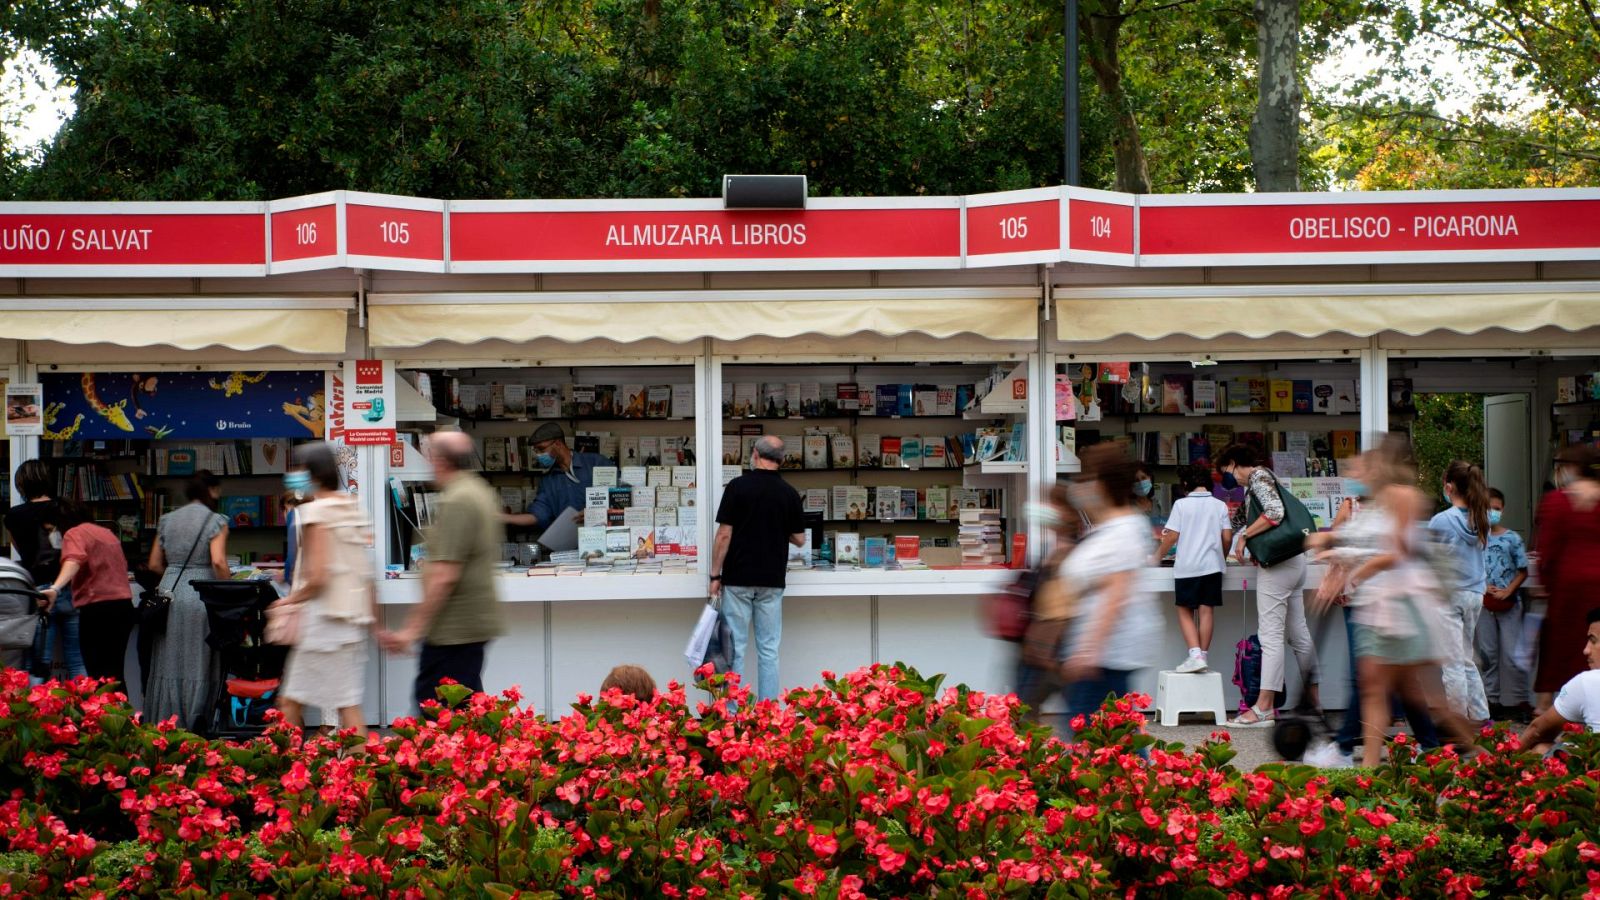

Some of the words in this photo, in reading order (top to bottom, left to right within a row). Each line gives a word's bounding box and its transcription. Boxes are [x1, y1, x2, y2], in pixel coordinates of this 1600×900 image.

[0, 224, 51, 250] UÑO
[56, 229, 66, 250] /
[72, 229, 153, 250] SALVAT
[296, 222, 317, 244] 106
[380, 221, 410, 244] 105
[606, 225, 723, 246] ALMUZARA
[732, 224, 807, 245] LIBROS
[999, 216, 1028, 239] 105
[1090, 216, 1111, 238] 104
[1290, 216, 1390, 239] OBELISCO
[1415, 214, 1518, 237] PICARONA
[228, 421, 252, 429] Bruño
